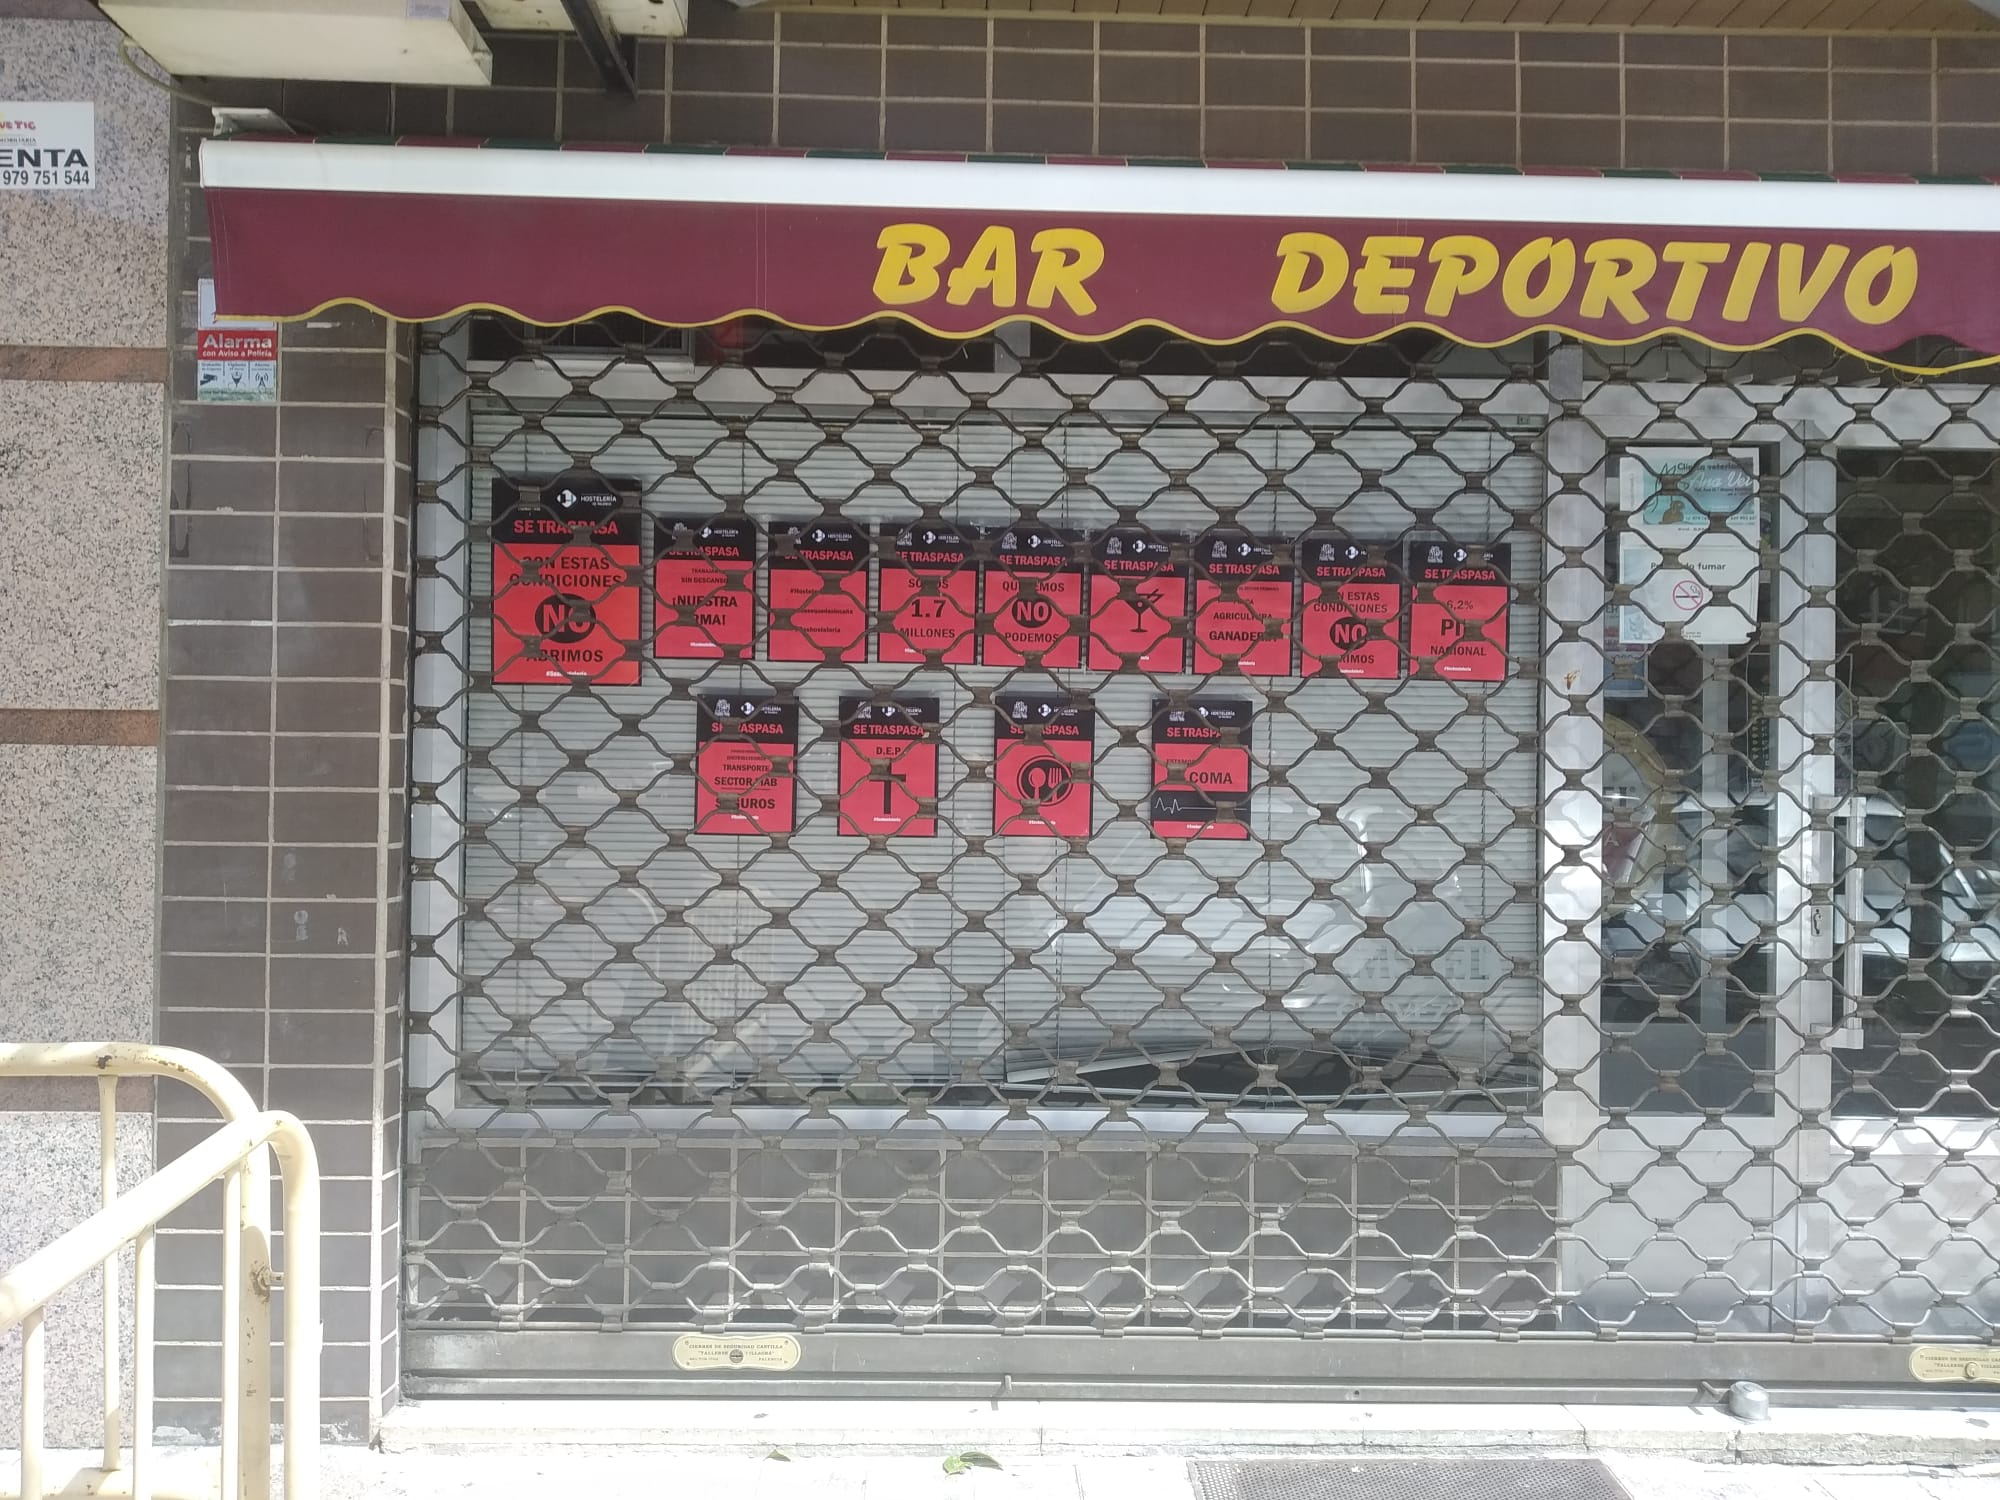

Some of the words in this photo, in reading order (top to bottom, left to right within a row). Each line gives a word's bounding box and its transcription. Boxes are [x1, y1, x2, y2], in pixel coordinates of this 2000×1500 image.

[3, 170, 29, 185] 979
[33, 170, 58, 185] 751
[64, 170, 90, 185] 544
[873, 223, 1105, 316] BAR
[1271, 231, 1918, 326] DEPORTIVO
[203, 333, 272, 348] Alarma
[218, 349, 239, 357] Aviso
[513, 519, 534, 533] SE
[561, 556, 610, 570] ESTAS
[910, 552, 965, 563] TRASPASA
[1104, 559, 1118, 570] SE
[1209, 563, 1223, 574] SE
[1698, 562, 1727, 571] fumar
[1316, 566, 1330, 577] SE
[1424, 568, 1438, 579] SE
[1347, 591, 1380, 601] ESTAS
[1016, 601, 1050, 622] NO
[900, 628, 956, 639] MILLONES
[853, 724, 867, 735] SE
[869, 724, 924, 736] TRASPASA
[1167, 726, 1182, 738] SE
[714, 776, 752, 787] SECTOR
[1189, 771, 1233, 785] COMA
